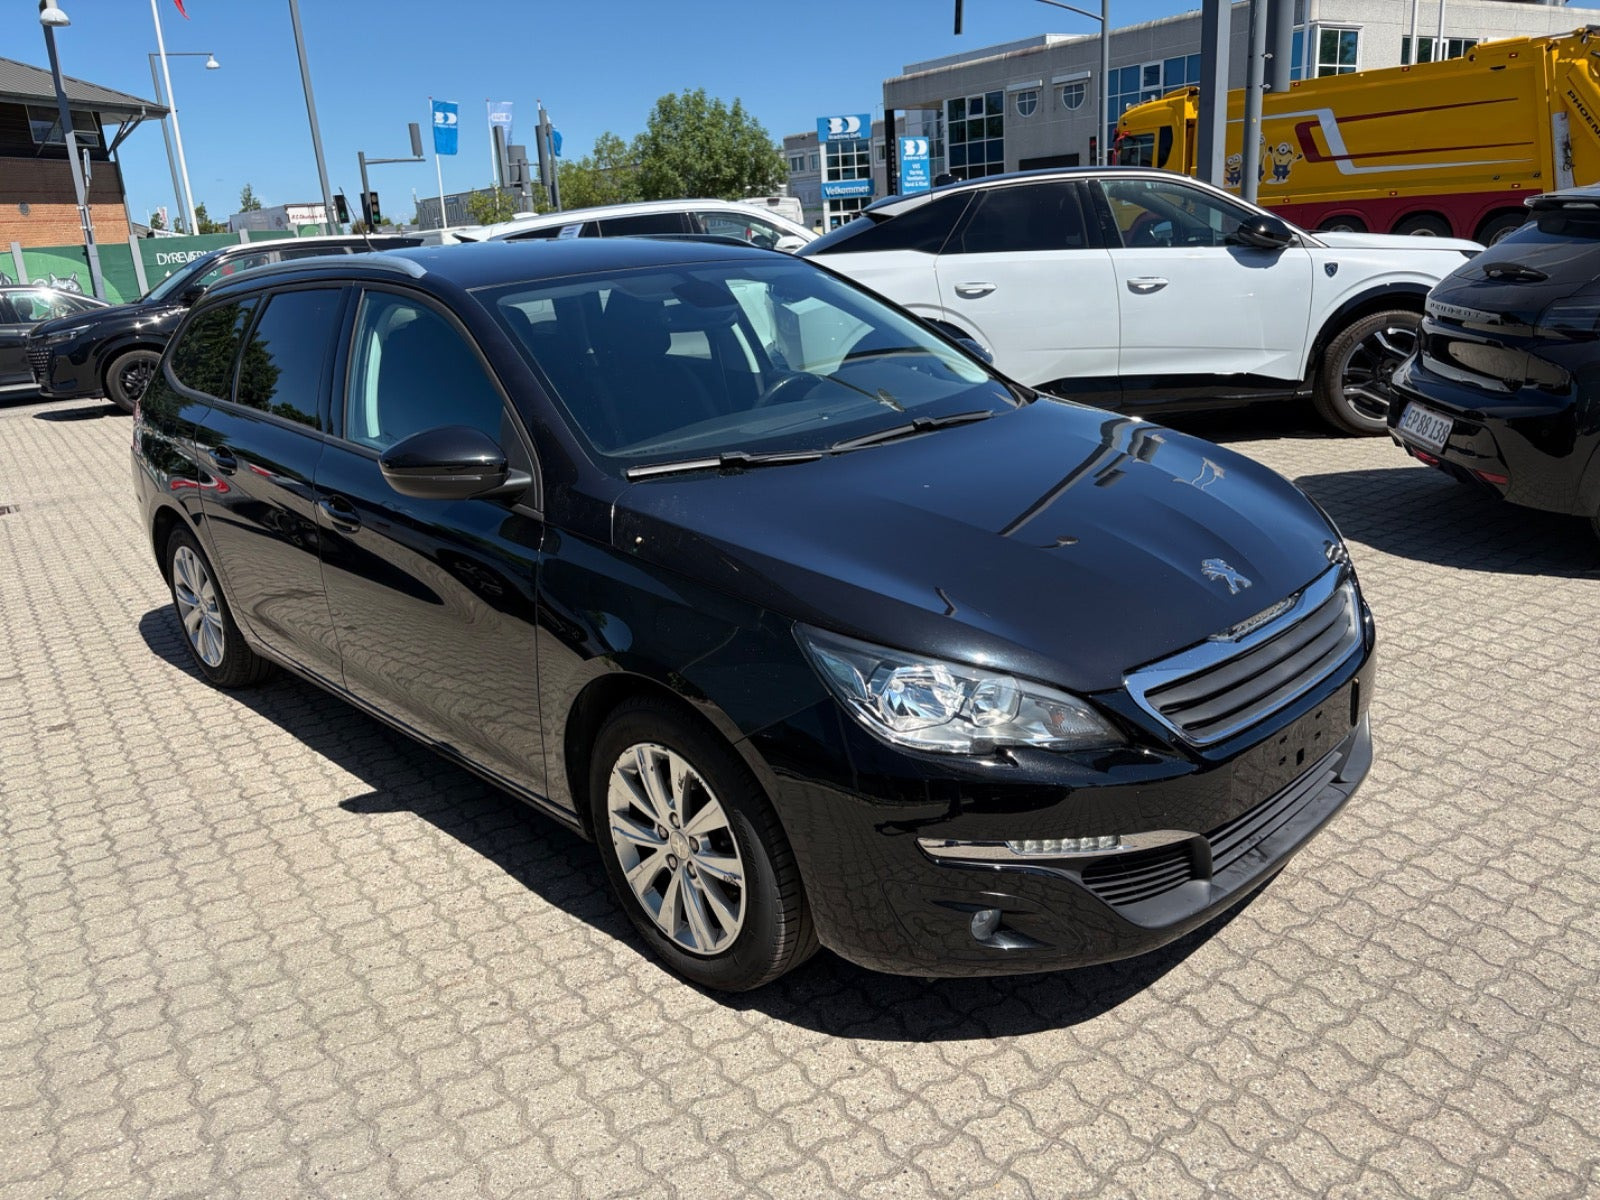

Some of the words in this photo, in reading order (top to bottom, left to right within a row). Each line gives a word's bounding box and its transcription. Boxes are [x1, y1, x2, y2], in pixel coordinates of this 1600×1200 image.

[1567, 90, 1600, 138] PHOEN
[825, 185, 870, 196] Velkommen
[1405, 409, 1420, 429] EP
[1415, 413, 1432, 436] 88
[1428, 419, 1451, 444] 138
